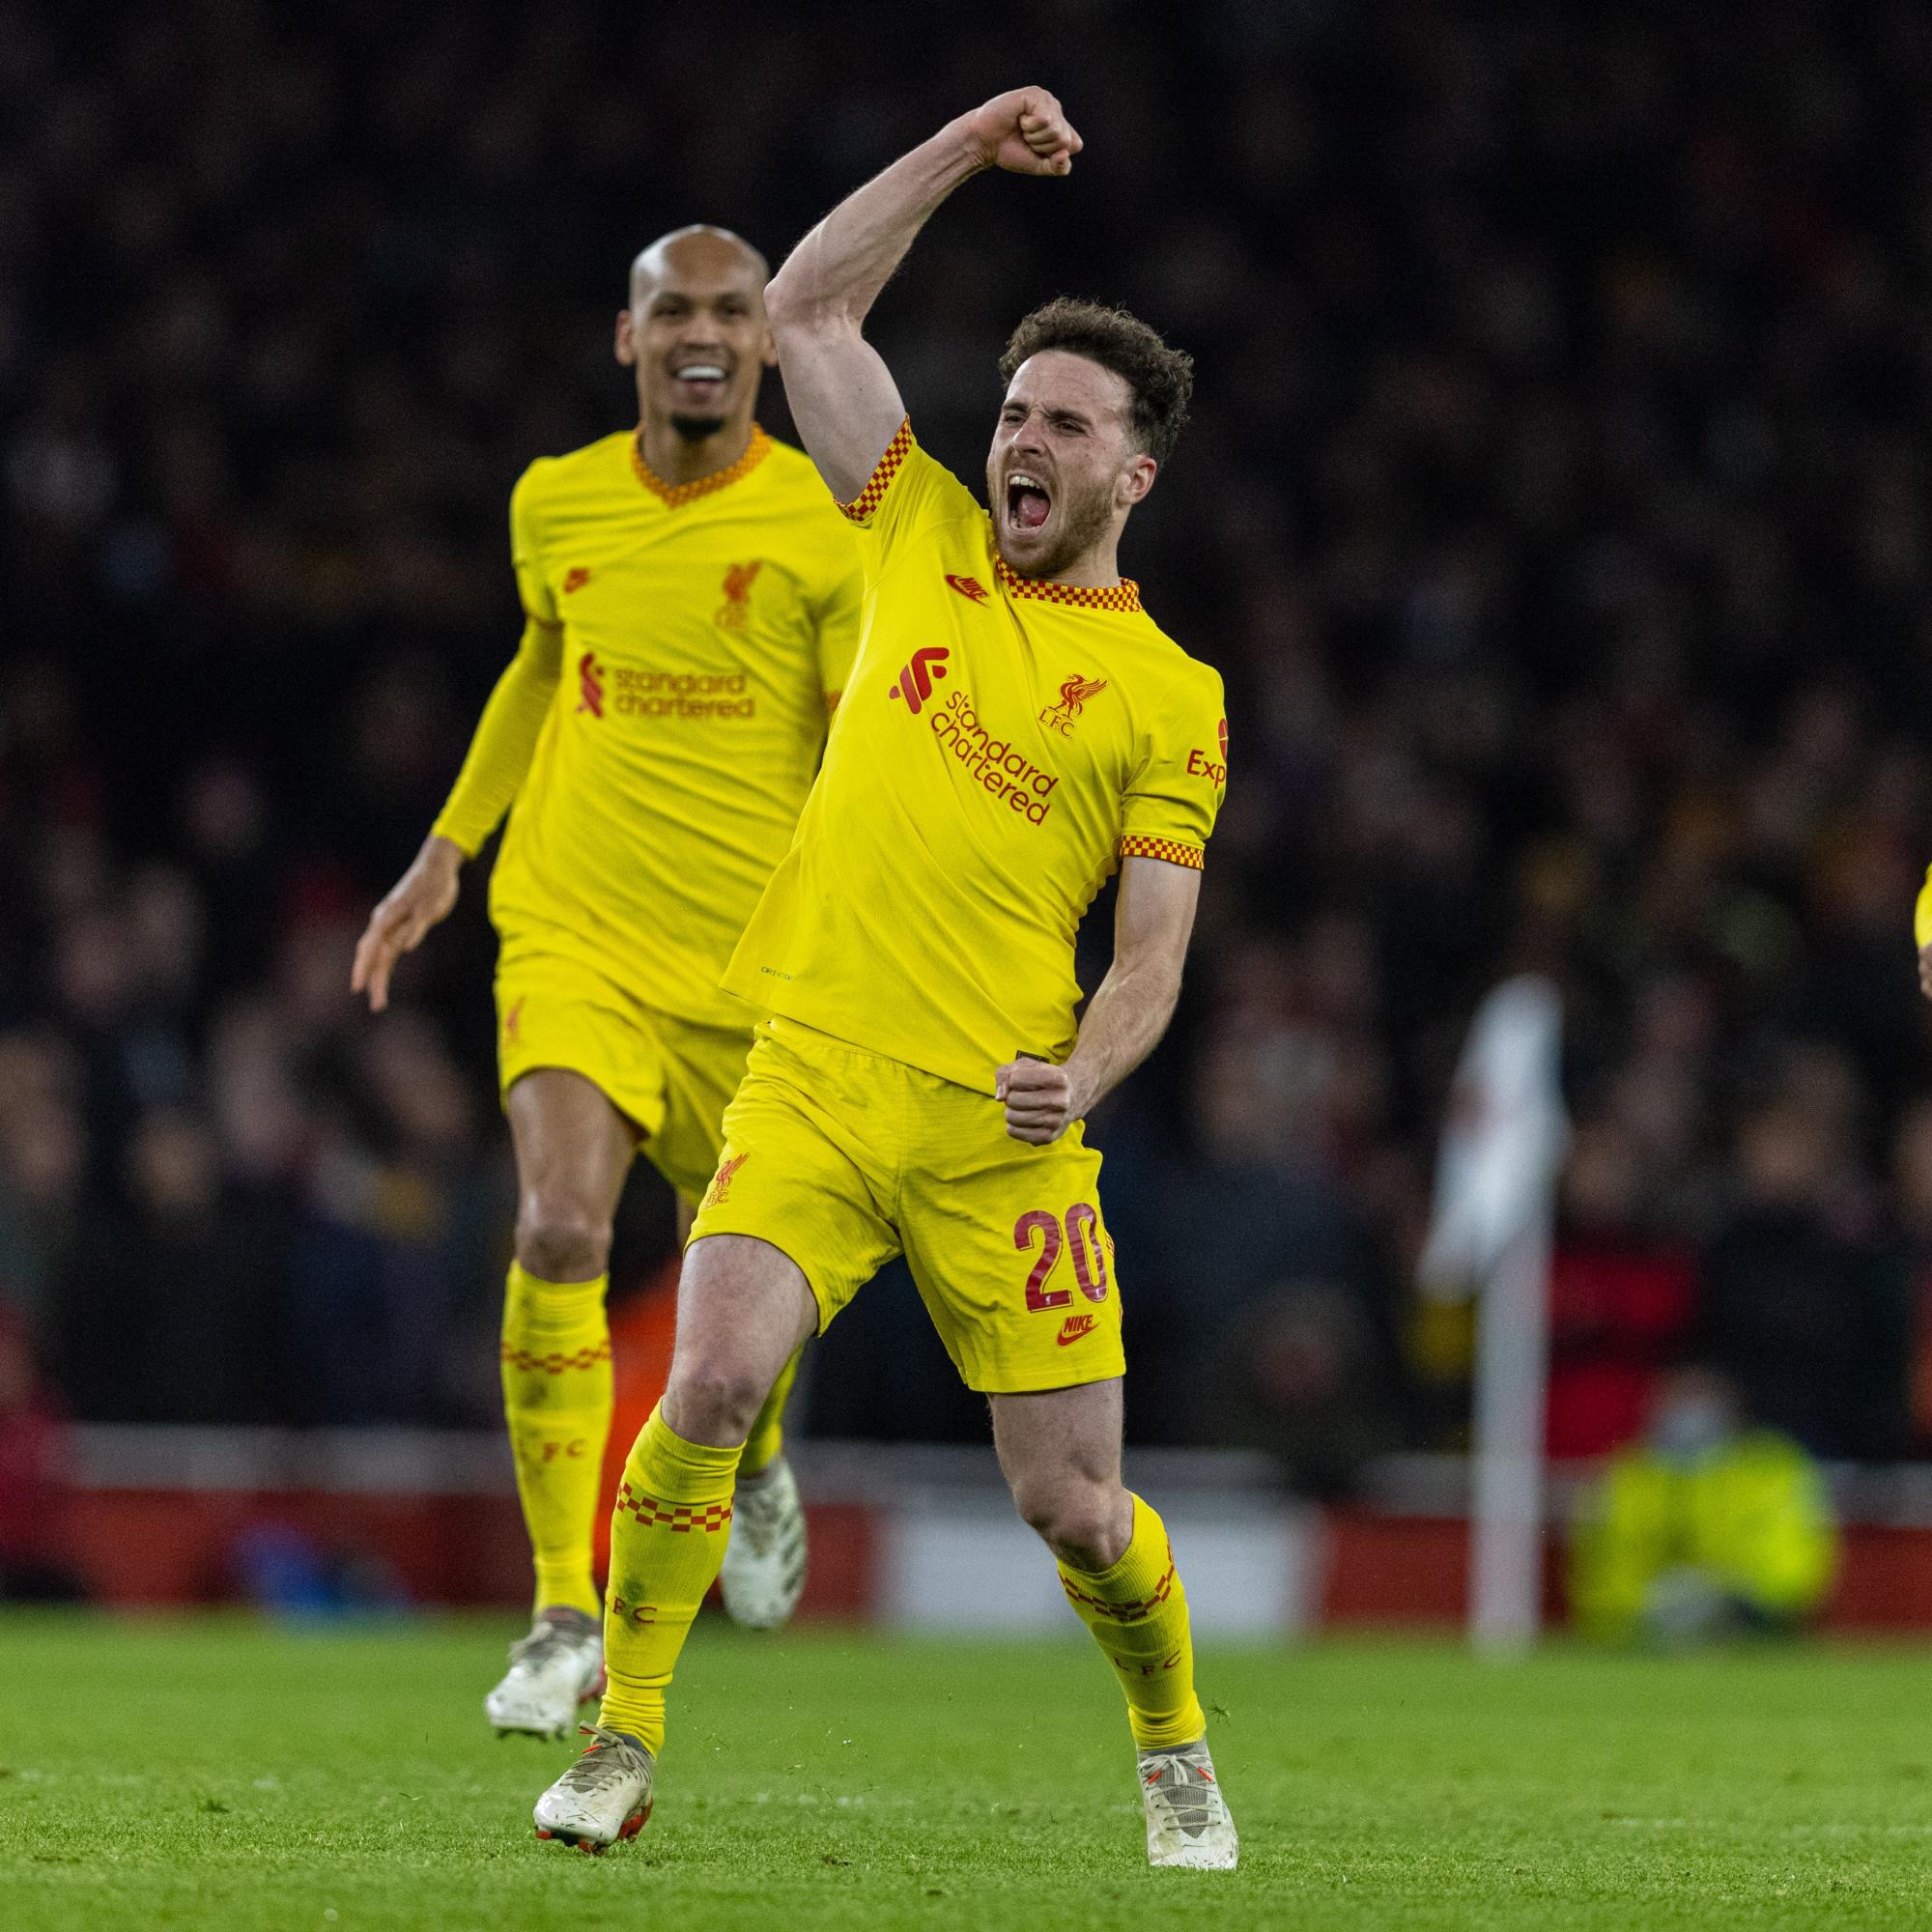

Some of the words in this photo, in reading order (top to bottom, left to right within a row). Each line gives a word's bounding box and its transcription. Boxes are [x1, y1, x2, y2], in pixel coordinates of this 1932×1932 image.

[614, 668, 747, 695] standard
[614, 694, 754, 719] chartered
[930, 712, 1051, 826] chartered
[946, 690, 1059, 797] standard
[1014, 1202, 1108, 1313] 20
[1064, 1314, 1094, 1334] NIKE
